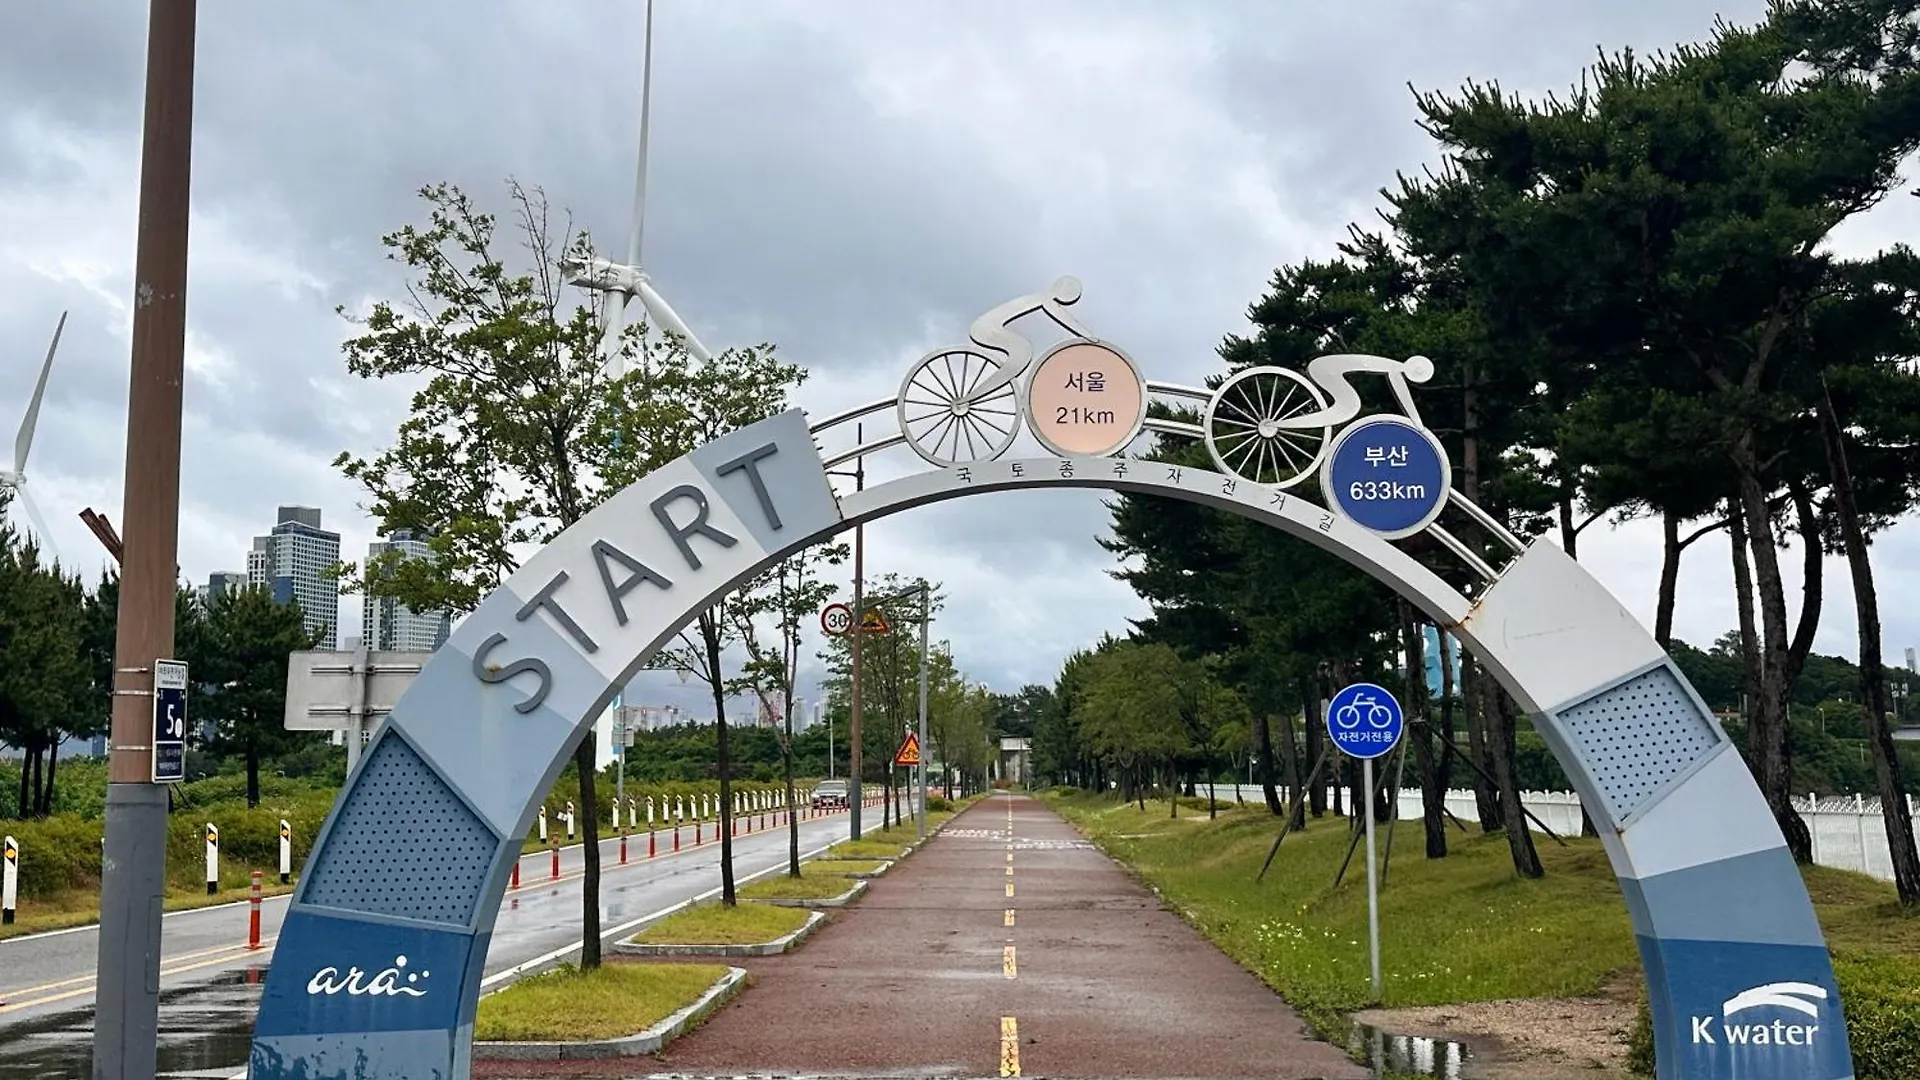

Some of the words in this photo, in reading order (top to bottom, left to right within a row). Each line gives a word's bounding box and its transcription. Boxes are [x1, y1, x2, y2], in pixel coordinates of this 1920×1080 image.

[1064, 371, 1106, 393] 서울
[1056, 406, 1115, 425] 21km
[1364, 445, 1409, 468] 부산
[1350, 481, 1425, 501] 633km
[472, 441, 783, 715] START
[828, 613, 847, 628] 30
[1338, 731, 1393, 743] 자전거전용
[1691, 1015, 1716, 1044] K
[1723, 1018, 1819, 1045] water
